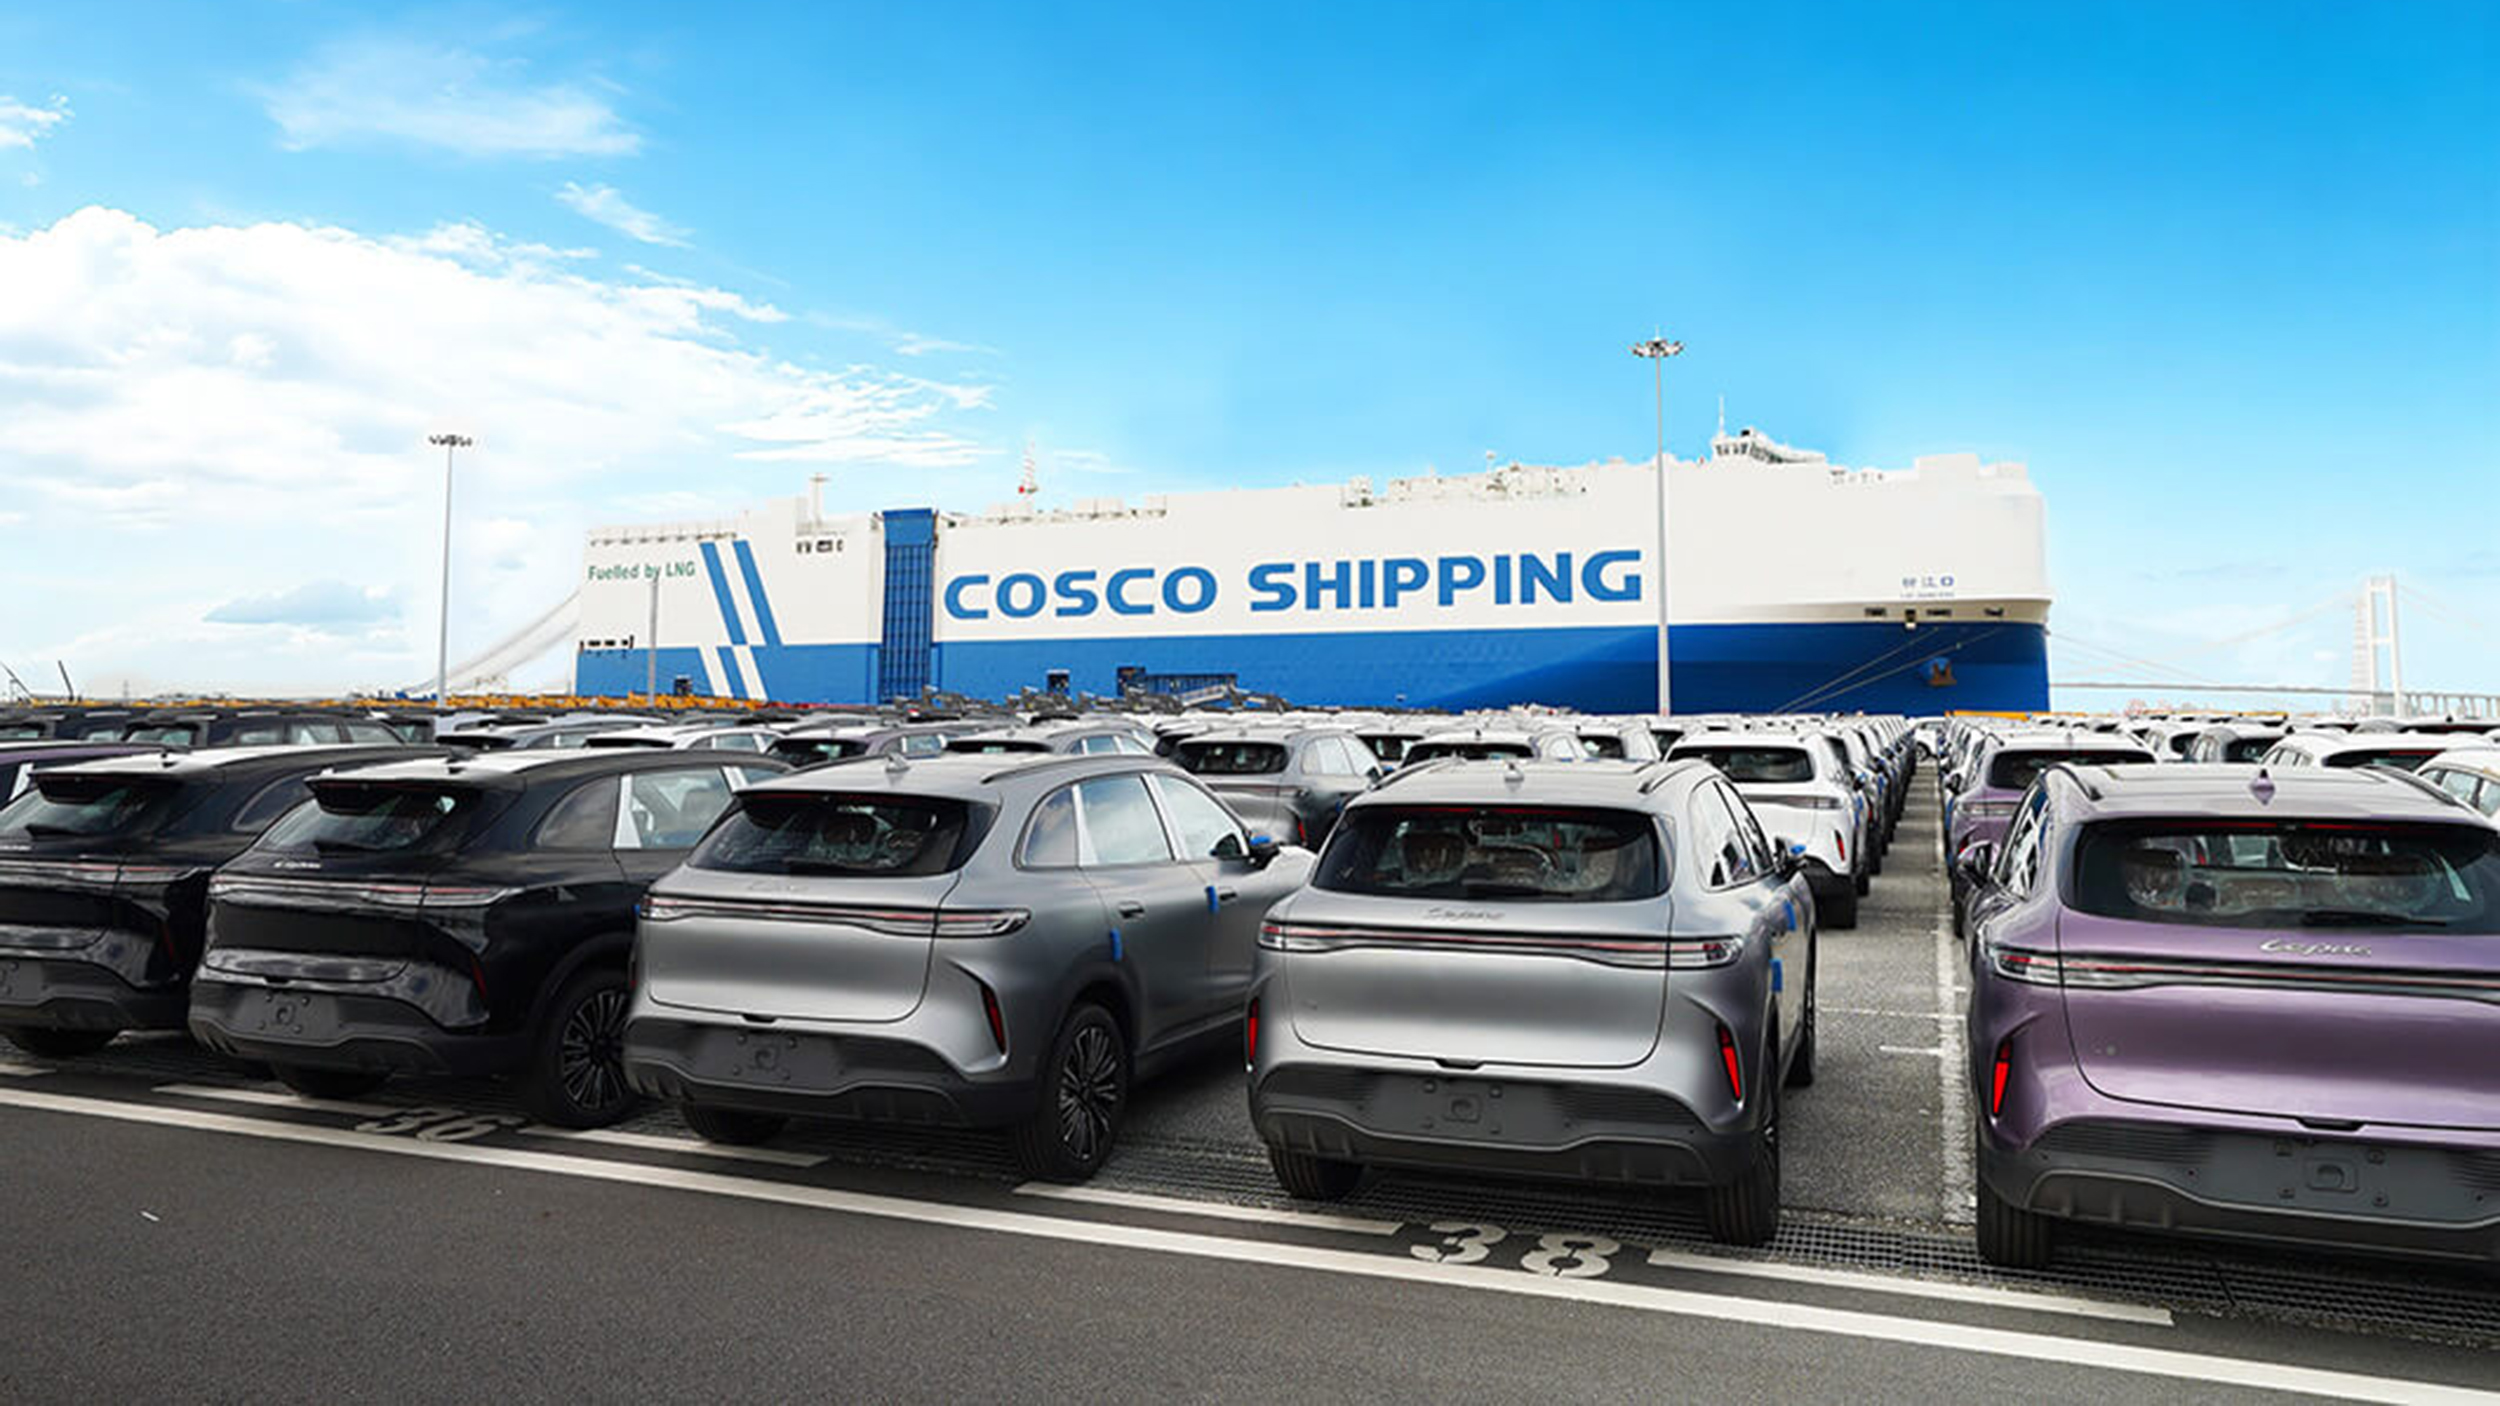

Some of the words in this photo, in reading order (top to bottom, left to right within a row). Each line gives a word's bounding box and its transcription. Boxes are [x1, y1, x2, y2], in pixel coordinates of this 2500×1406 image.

[587, 564, 639, 580] Fuelled
[644, 562, 661, 583] by
[665, 560, 696, 577] LNG
[943, 566, 1218, 619] COSCO
[1248, 549, 1642, 612] SHIPPING
[1410, 1221, 1621, 1277] 38
